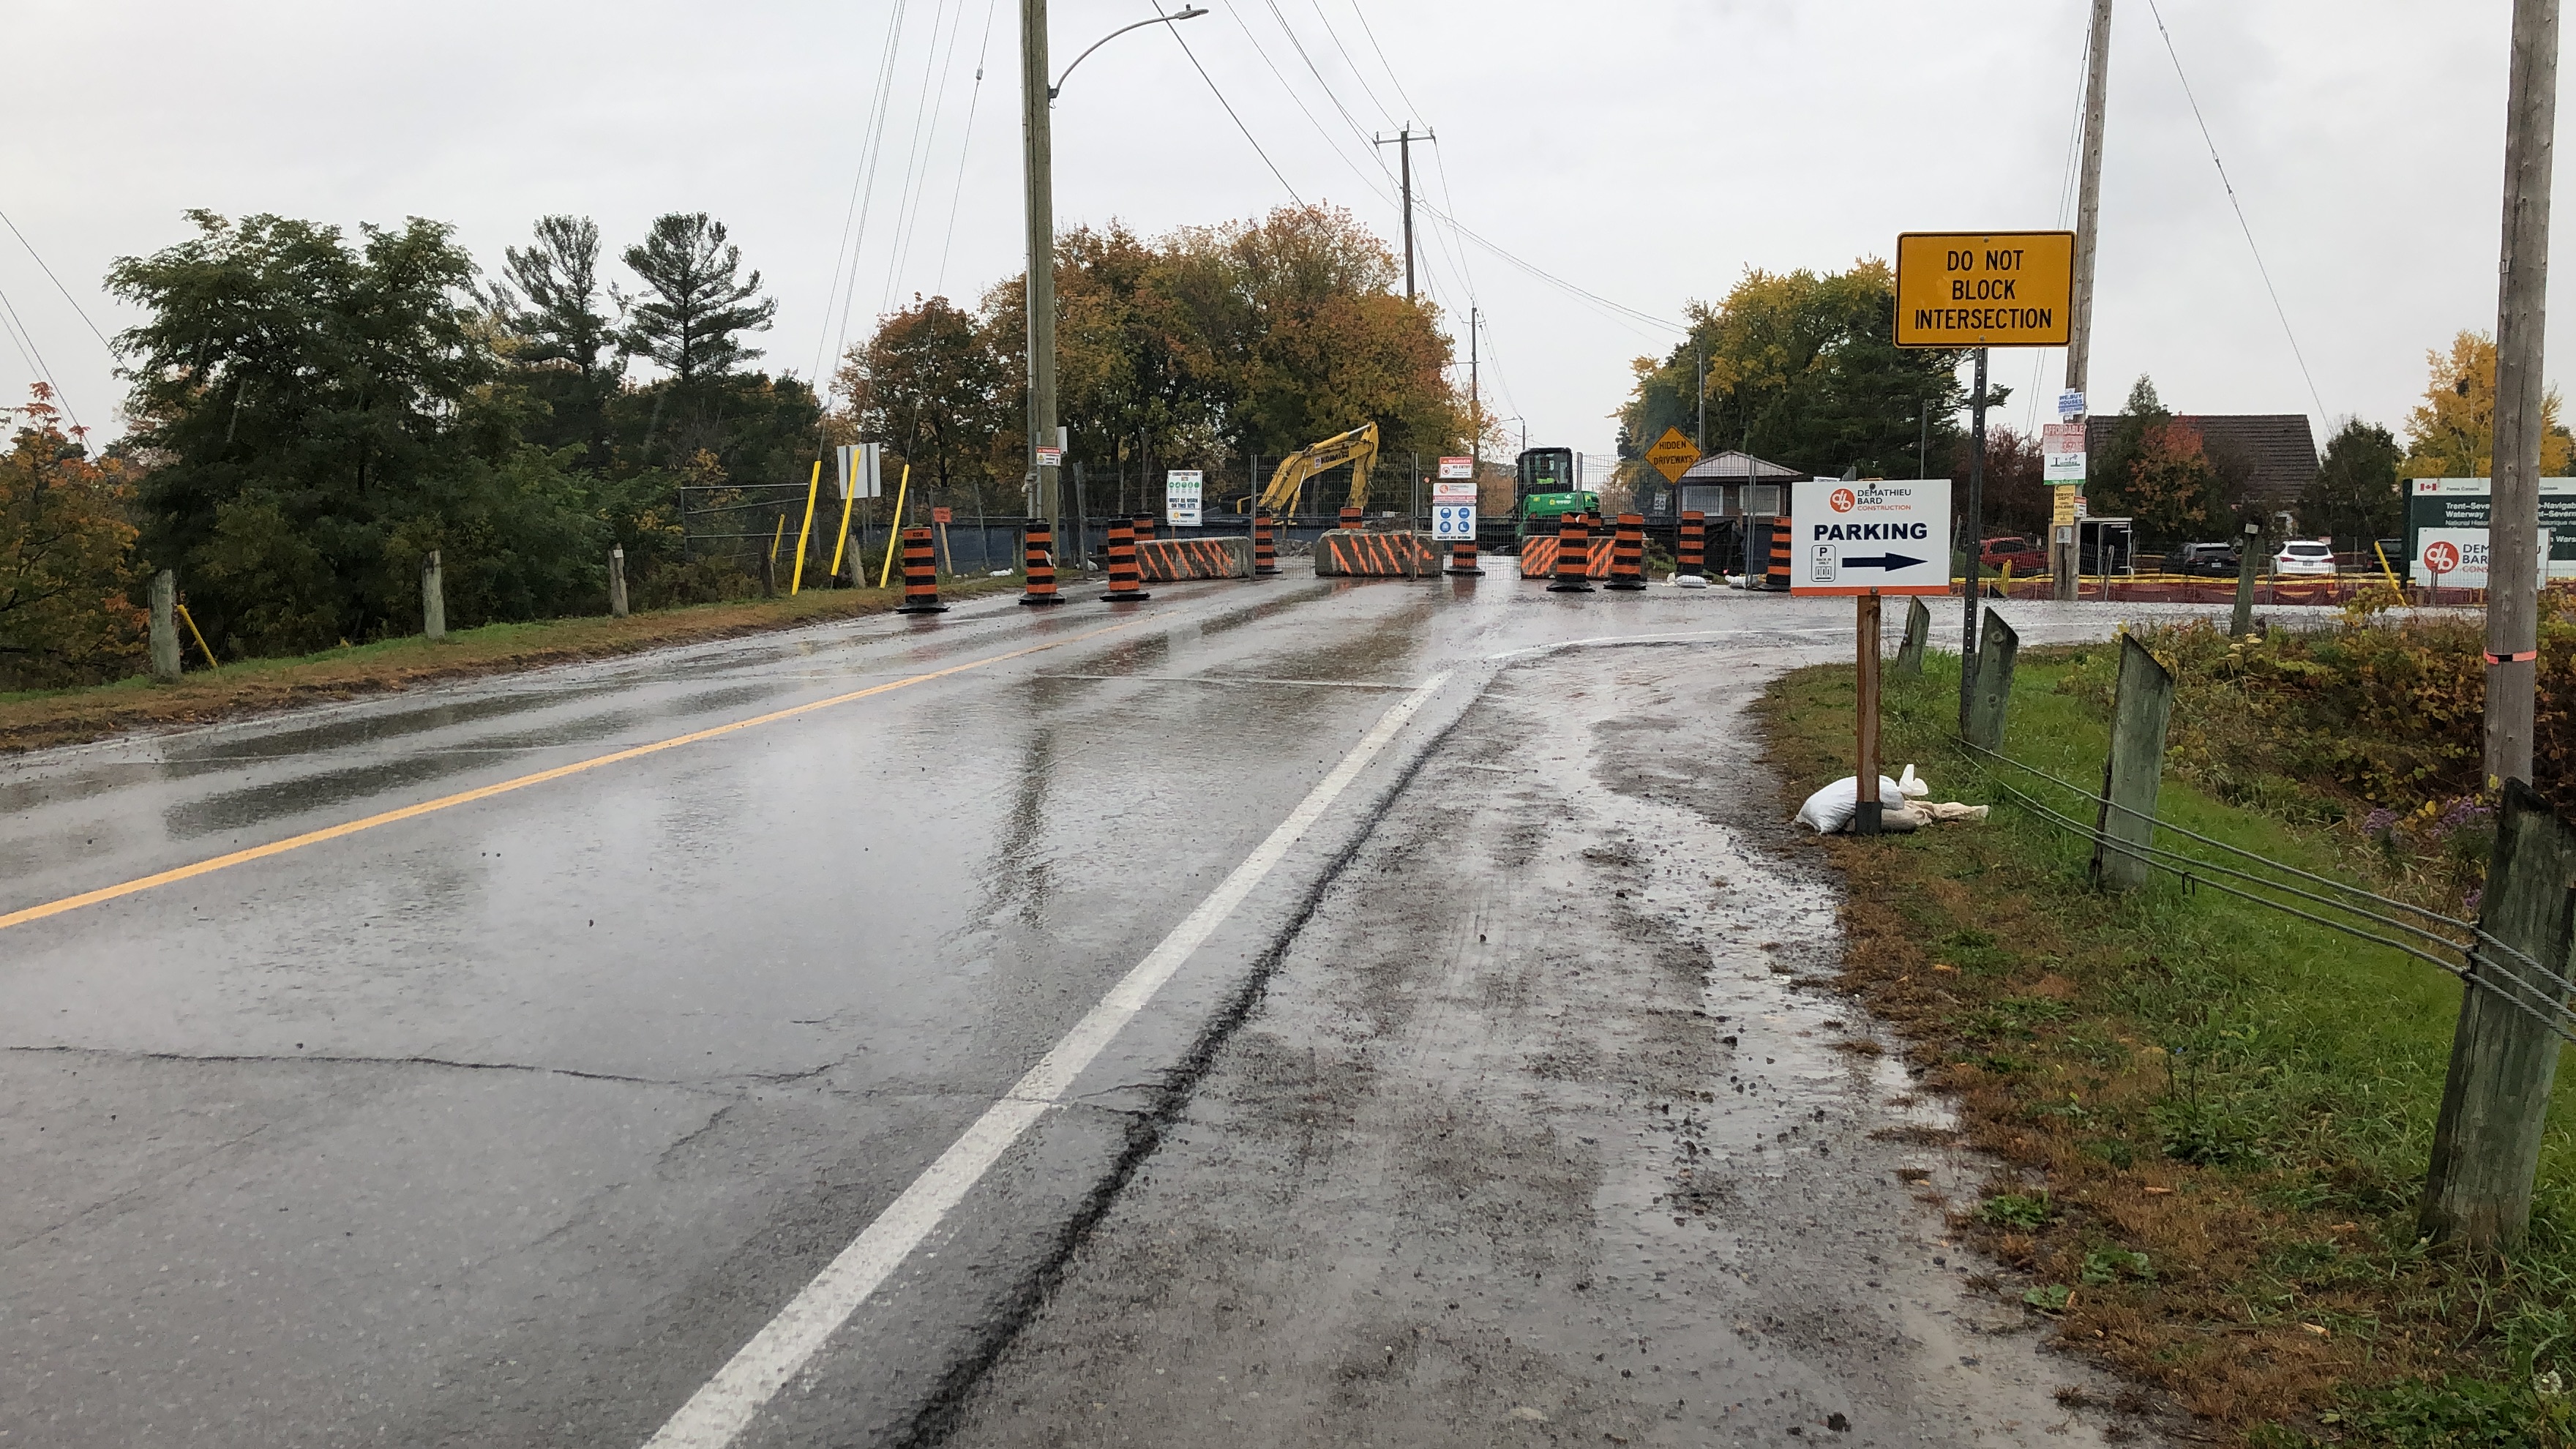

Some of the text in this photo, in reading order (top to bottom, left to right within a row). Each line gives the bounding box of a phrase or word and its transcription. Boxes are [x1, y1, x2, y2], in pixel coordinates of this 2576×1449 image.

[1947, 250, 2024, 271] DO NOT
[1952, 279, 2016, 300] BLOCK
[1914, 308, 2052, 329] INTERSECTION
[2044, 425, 2084, 435] AFFORDABLE
[1659, 441, 1686, 450] HIDDEN
[1654, 454, 1693, 465] DRIVEWAYS
[1857, 489, 1912, 497] DEMATHIEU
[1654, 500, 1665, 508] 50
[1857, 497, 1883, 505] BARD
[2445, 510, 2485, 519] Waterway
[1813, 523, 1928, 542] PARKING
[1819, 547, 1828, 557] P
[2462, 555, 2489, 564] BAR
